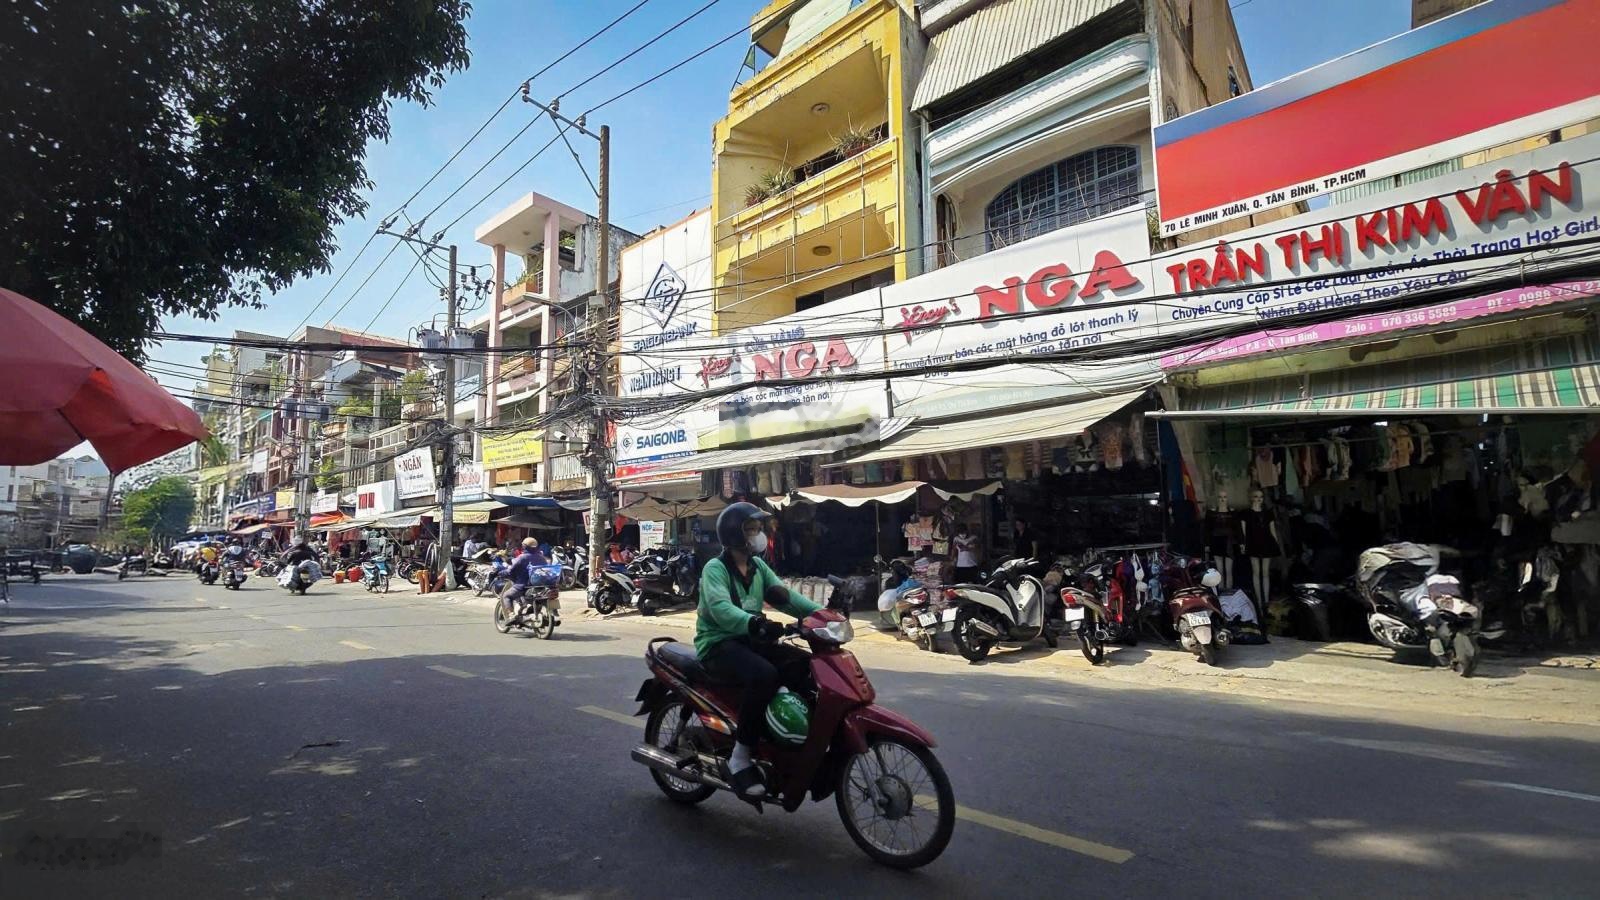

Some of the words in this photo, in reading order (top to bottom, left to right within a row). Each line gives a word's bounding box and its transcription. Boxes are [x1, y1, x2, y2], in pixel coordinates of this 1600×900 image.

[1165, 222, 1176, 233] 70
[1179, 215, 1190, 229] LÊ
[1194, 210, 1219, 225] MINH
[1222, 201, 1250, 217] XUÂN,
[1253, 198, 1263, 209] Q.
[1265, 191, 1285, 205] TÂN
[1290, 183, 1319, 199] BÌNH,
[1323, 168, 1366, 190] TP.HCM
[1166, 240, 1265, 296] TRẦN
[1275, 222, 1344, 270] THỊ
[1355, 196, 1449, 251] KIM
[1455, 161, 1573, 225] VÂN
[973, 250, 1140, 321] NGA
[1171, 305, 1212, 321] Chuyên
[1214, 299, 1243, 312] Cung
[1249, 290, 1270, 307] Cấp
[1471, 235, 1521, 255] Trang
[1526, 225, 1560, 245] Hot
[1364, 286, 1400, 300] Theo
[1403, 279, 1432, 293] Yêu
[632, 322, 697, 352] SAIGONBANK
[955, 346, 974, 359] bán
[975, 343, 994, 354] các
[995, 337, 1017, 350] mặt
[1019, 331, 1048, 345] hàng
[1051, 322, 1066, 337] đồ
[1069, 322, 1085, 334] lót
[1088, 312, 1124, 329] thanh
[1128, 308, 1139, 323] lý
[1344, 322, 1367, 335] Zalo
[1381, 315, 1402, 329] 070
[1405, 311, 1425, 324] 336
[752, 336, 856, 382] NGA
[636, 429, 687, 450] SAIGONB
